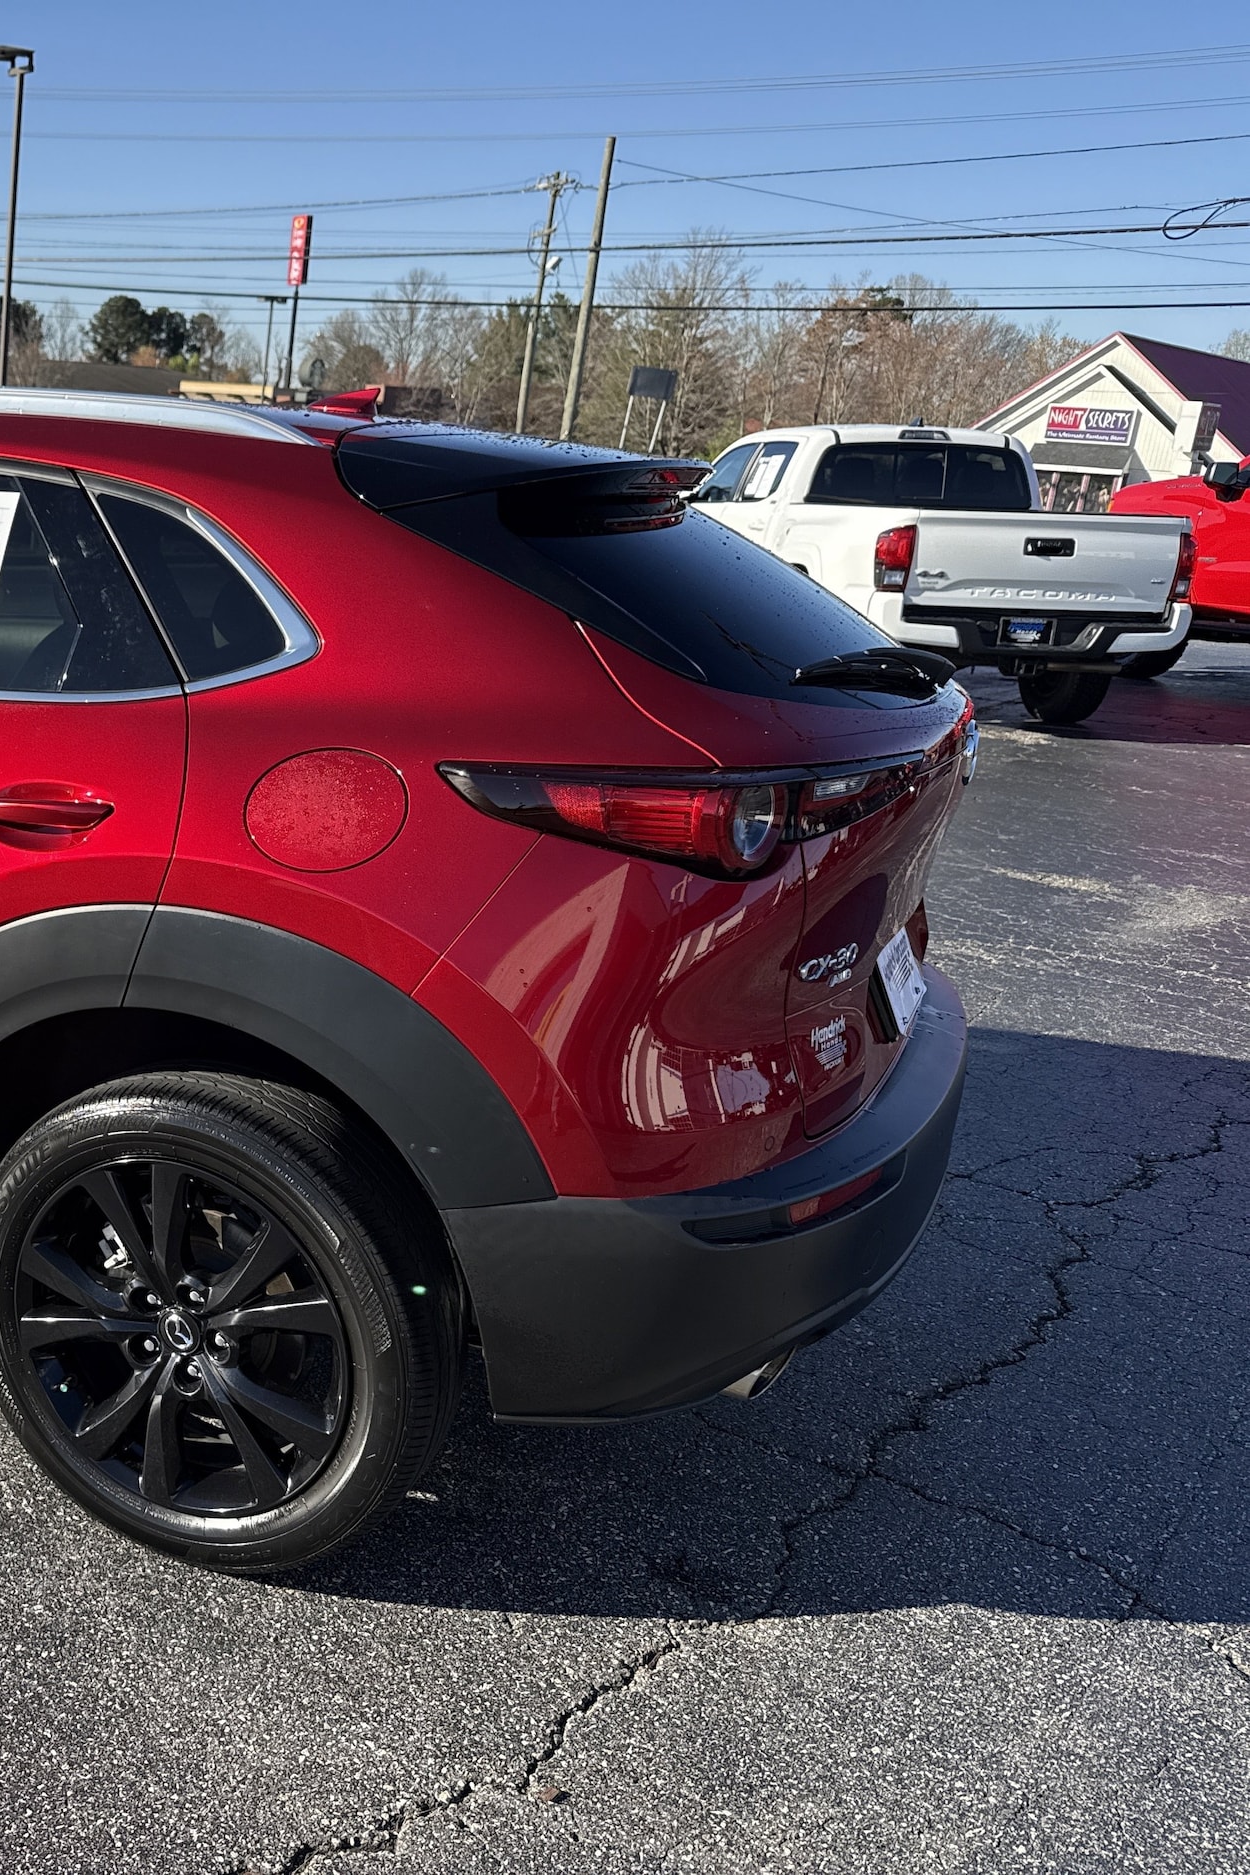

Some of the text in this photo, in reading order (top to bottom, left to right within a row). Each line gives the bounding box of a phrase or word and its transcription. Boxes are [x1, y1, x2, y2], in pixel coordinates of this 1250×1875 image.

[1087, 411, 1131, 430] SECRETS
[965, 586, 1116, 602] TACOMA
[798, 943, 858, 981] CX-30
[827, 968, 852, 988] AWD
[810, 1013, 846, 1052] Hendrick
